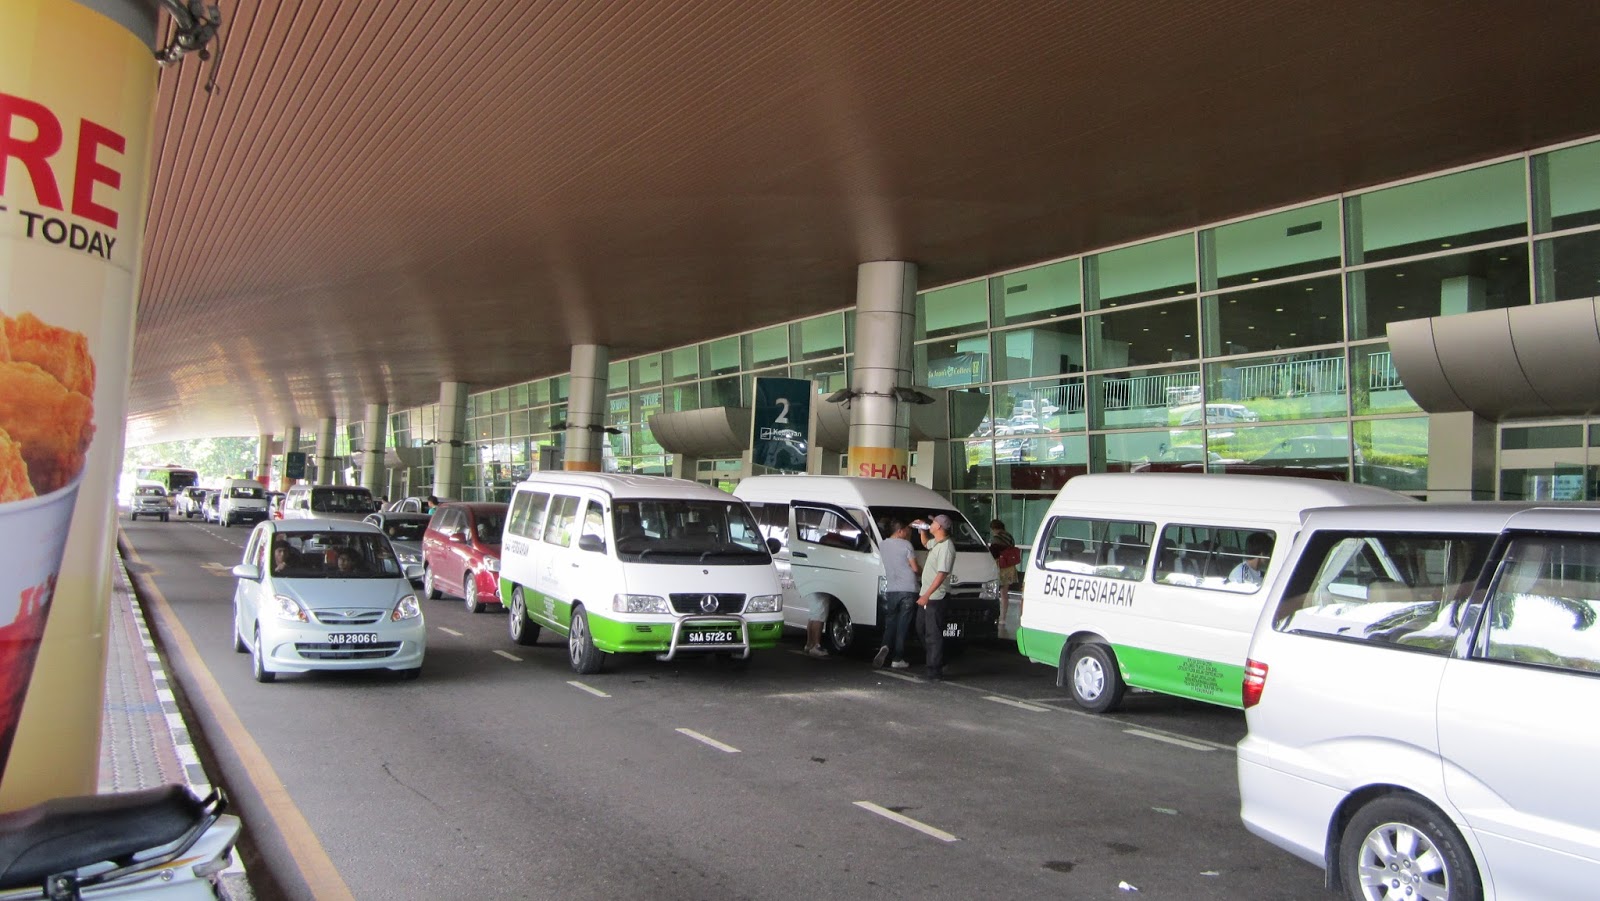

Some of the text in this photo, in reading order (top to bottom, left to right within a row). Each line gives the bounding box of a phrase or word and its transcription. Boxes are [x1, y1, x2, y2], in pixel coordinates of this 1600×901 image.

[0, 91, 126, 230] RE
[19, 209, 117, 261] TODAY
[774, 397, 790, 424] 2
[858, 462, 908, 480] SHAR
[1043, 574, 1137, 607] BAS PERSIARAN
[689, 632, 733, 642] SAA 5722 C
[947, 622, 958, 630] SAB
[328, 633, 378, 644] SAB 2806 G
